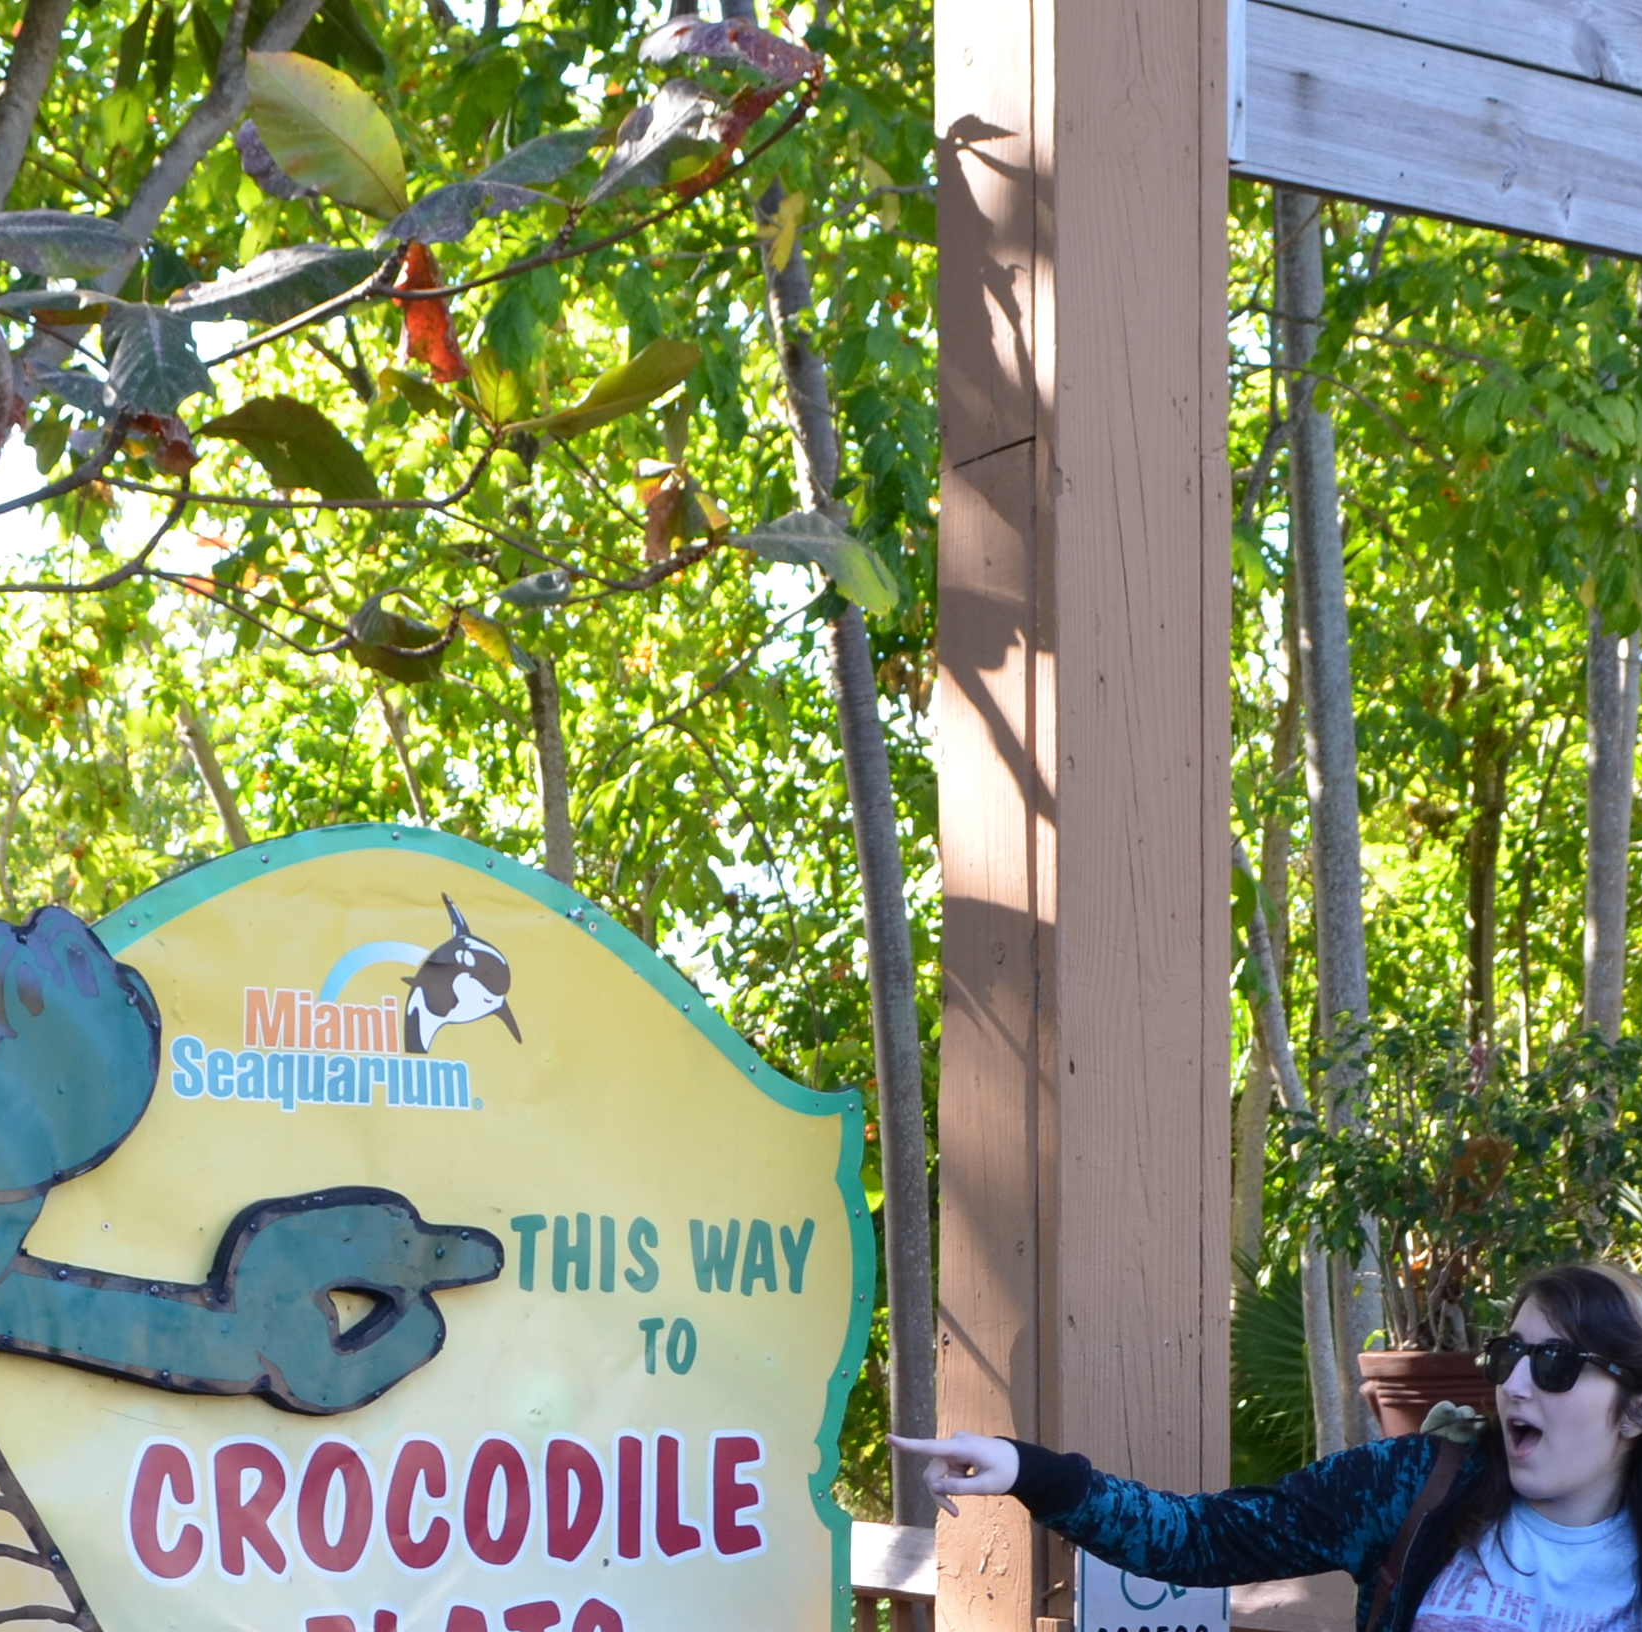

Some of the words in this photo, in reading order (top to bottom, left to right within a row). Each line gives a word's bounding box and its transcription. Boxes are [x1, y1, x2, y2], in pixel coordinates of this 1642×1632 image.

[244, 987, 399, 1054] Miami
[171, 1036, 470, 1112] Seaquarium
[510, 1212, 660, 1294] THIS
[688, 1216, 816, 1298] WAY
[638, 1317, 698, 1376] TO
[129, 1433, 763, 1579] CROCODILE
[1486, 1583, 1537, 1627] THE
